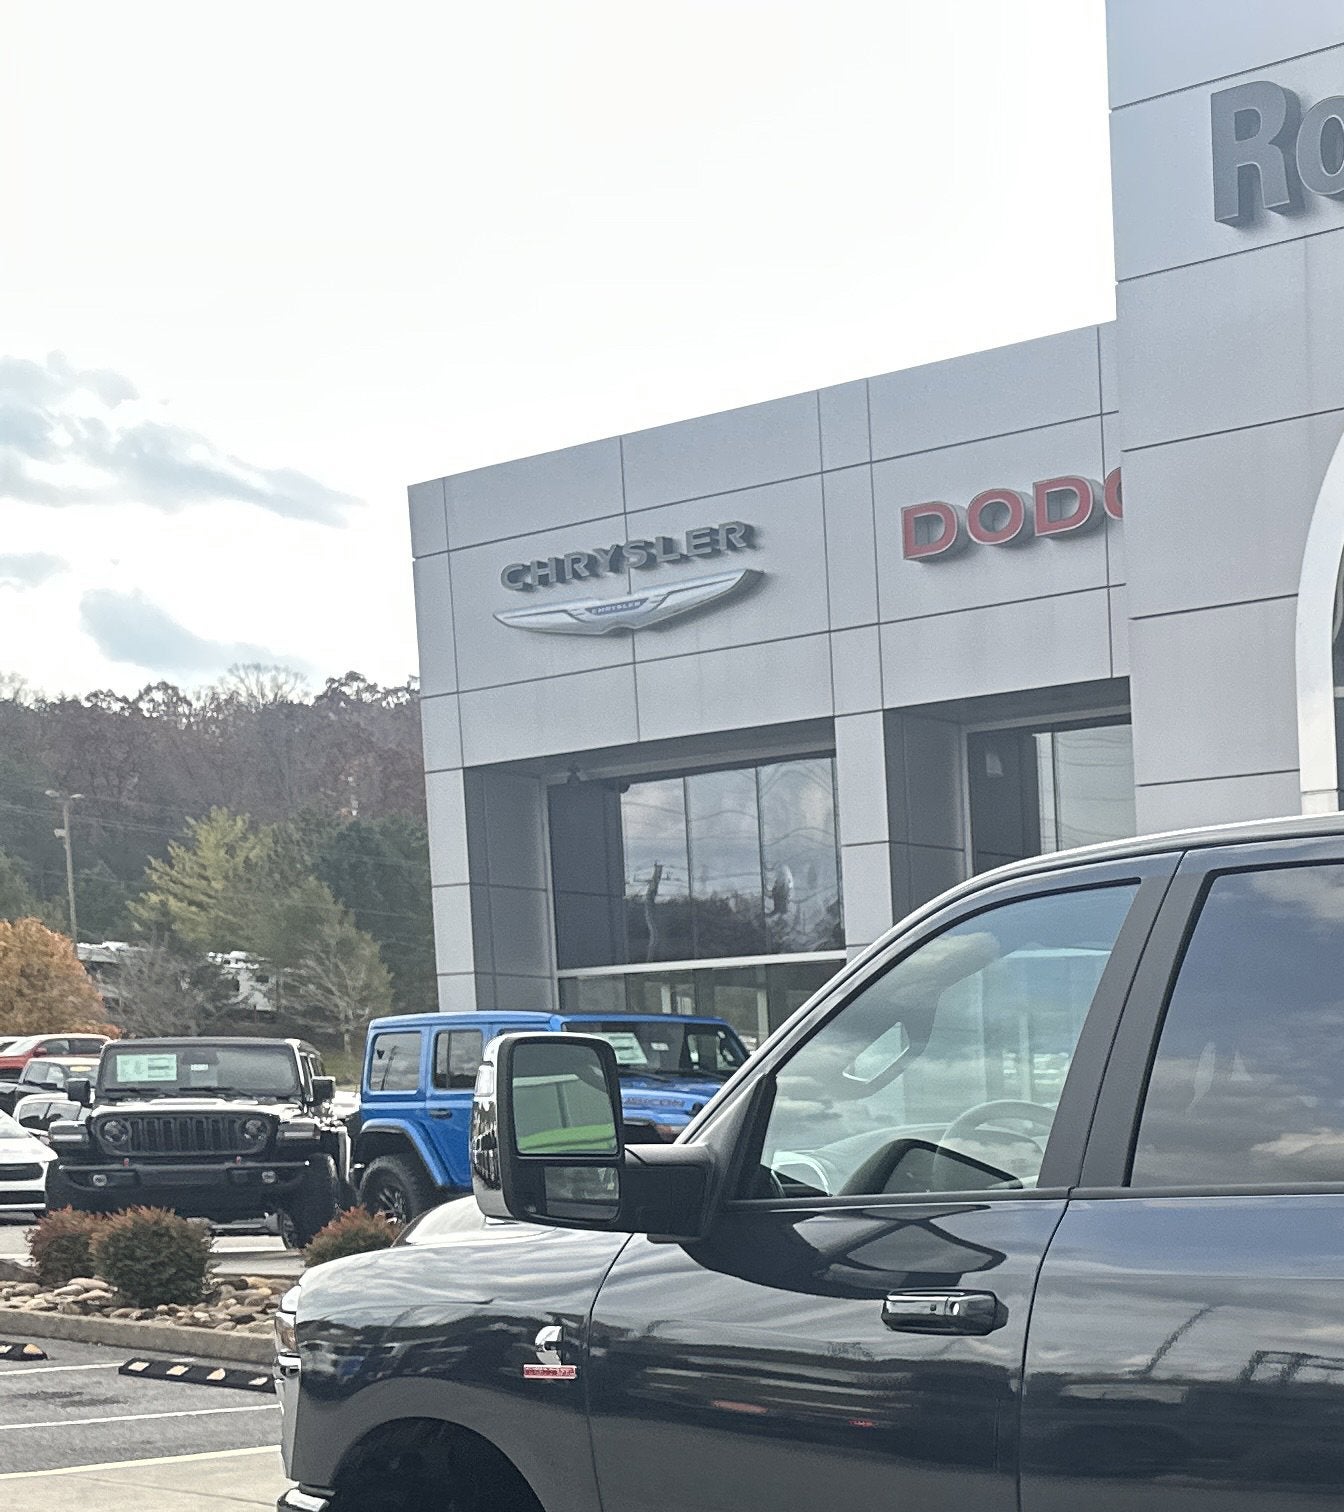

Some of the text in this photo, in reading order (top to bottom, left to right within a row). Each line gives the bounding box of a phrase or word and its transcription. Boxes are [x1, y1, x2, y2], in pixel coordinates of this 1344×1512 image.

[902, 466, 1123, 561] DOD
[500, 520, 754, 592] CHRYSLER
[623, 1096, 686, 1108] UBICON
